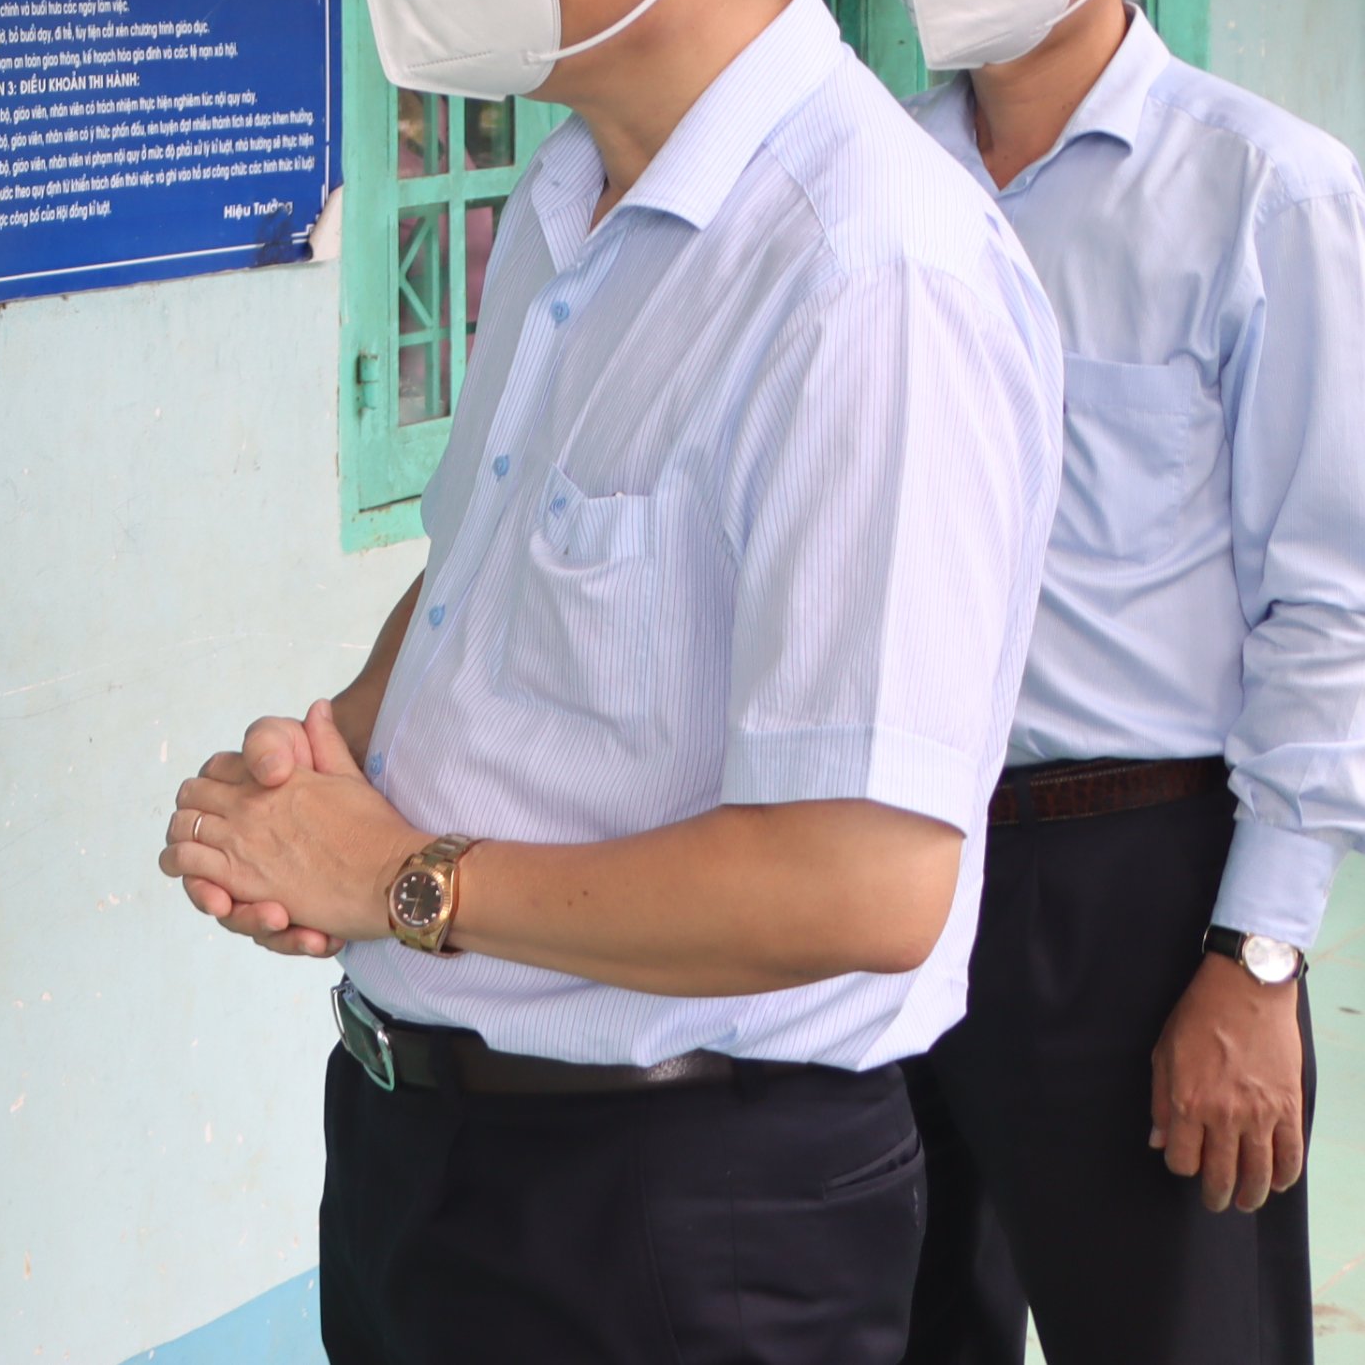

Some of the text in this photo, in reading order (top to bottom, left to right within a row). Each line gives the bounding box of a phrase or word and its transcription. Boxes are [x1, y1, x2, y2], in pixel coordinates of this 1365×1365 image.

[7, 80, 17, 96] 3:
[19, 73, 47, 95] ĐIỀU
[48, 70, 87, 92] KHOẢN
[88, 74, 104, 89] THI
[106, 70, 140, 88] HÀNH:
